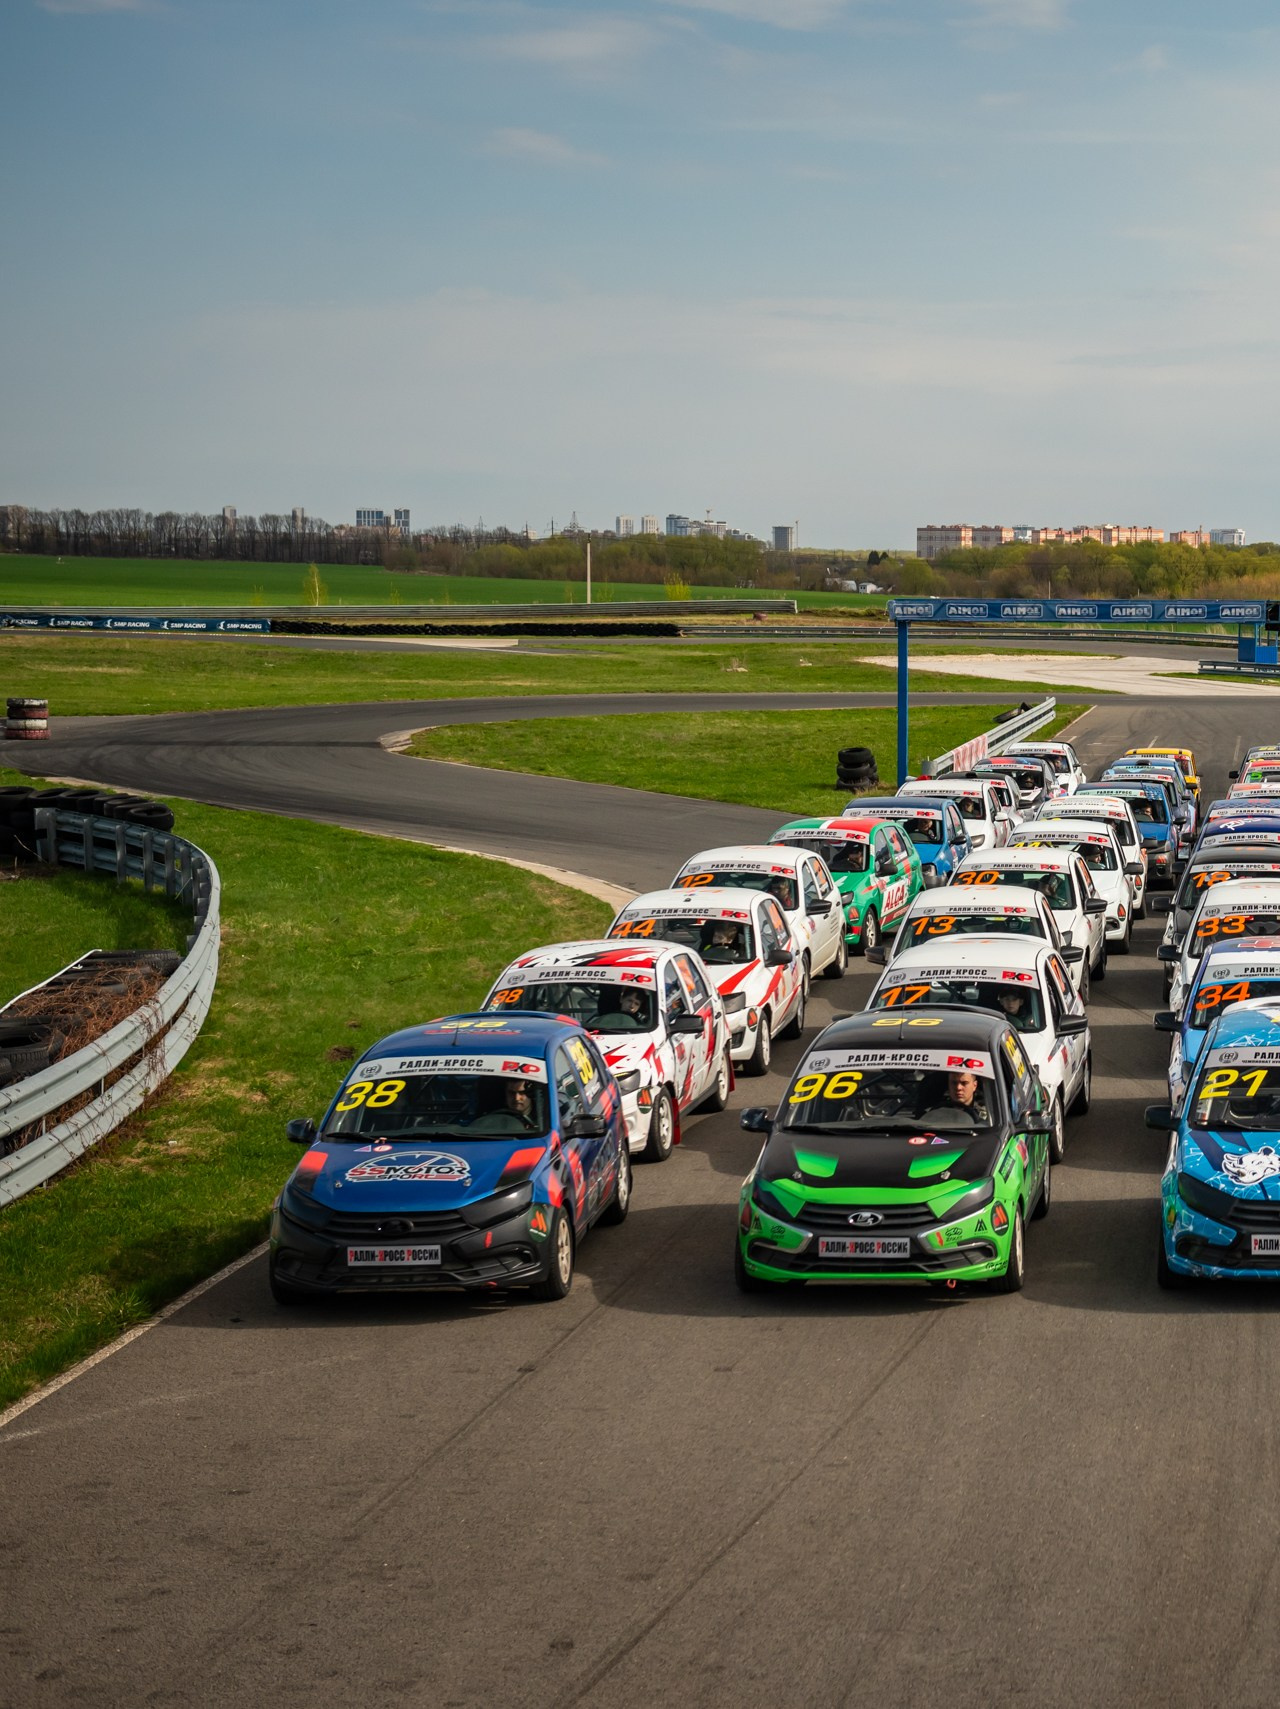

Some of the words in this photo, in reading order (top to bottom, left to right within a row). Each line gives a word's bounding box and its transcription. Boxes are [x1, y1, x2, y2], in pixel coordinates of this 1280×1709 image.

[949, 606, 986, 615] AIMOL
[1003, 606, 1041, 615] AIMOL
[1058, 607, 1096, 616] AIMOL
[1112, 607, 1150, 616] AIMOL
[1222, 607, 1259, 616] AIMOL
[679, 873, 715, 888] 12
[954, 871, 1000, 886] 30
[1193, 872, 1231, 888] 18
[883, 884, 905, 912] ALGA
[612, 919, 657, 937] 44
[912, 916, 957, 936] 13
[1196, 915, 1246, 937] 33
[538, 970, 606, 978] РАЛЛИ-КРОСС
[881, 985, 931, 1007] 17
[1195, 981, 1250, 1012] 34
[441, 1021, 508, 1029] 38
[871, 1018, 944, 1027] 96
[399, 1059, 484, 1069] РАЛЛИ-КРОСС
[848, 1054, 929, 1063] РАЛЛИ-КРОСС
[789, 1071, 863, 1104] 96
[1199, 1069, 1269, 1099] 21
[335, 1080, 407, 1112] 38
[348, 1165, 467, 1177] SSMOTOR
[820, 1241, 875, 1254] РАЛЛИ-КРОСС
[876, 1241, 908, 1254] РОССИИ
[349, 1249, 405, 1262] РАЛЛИ-КРОСС
[406, 1249, 439, 1261] РОССИИ
